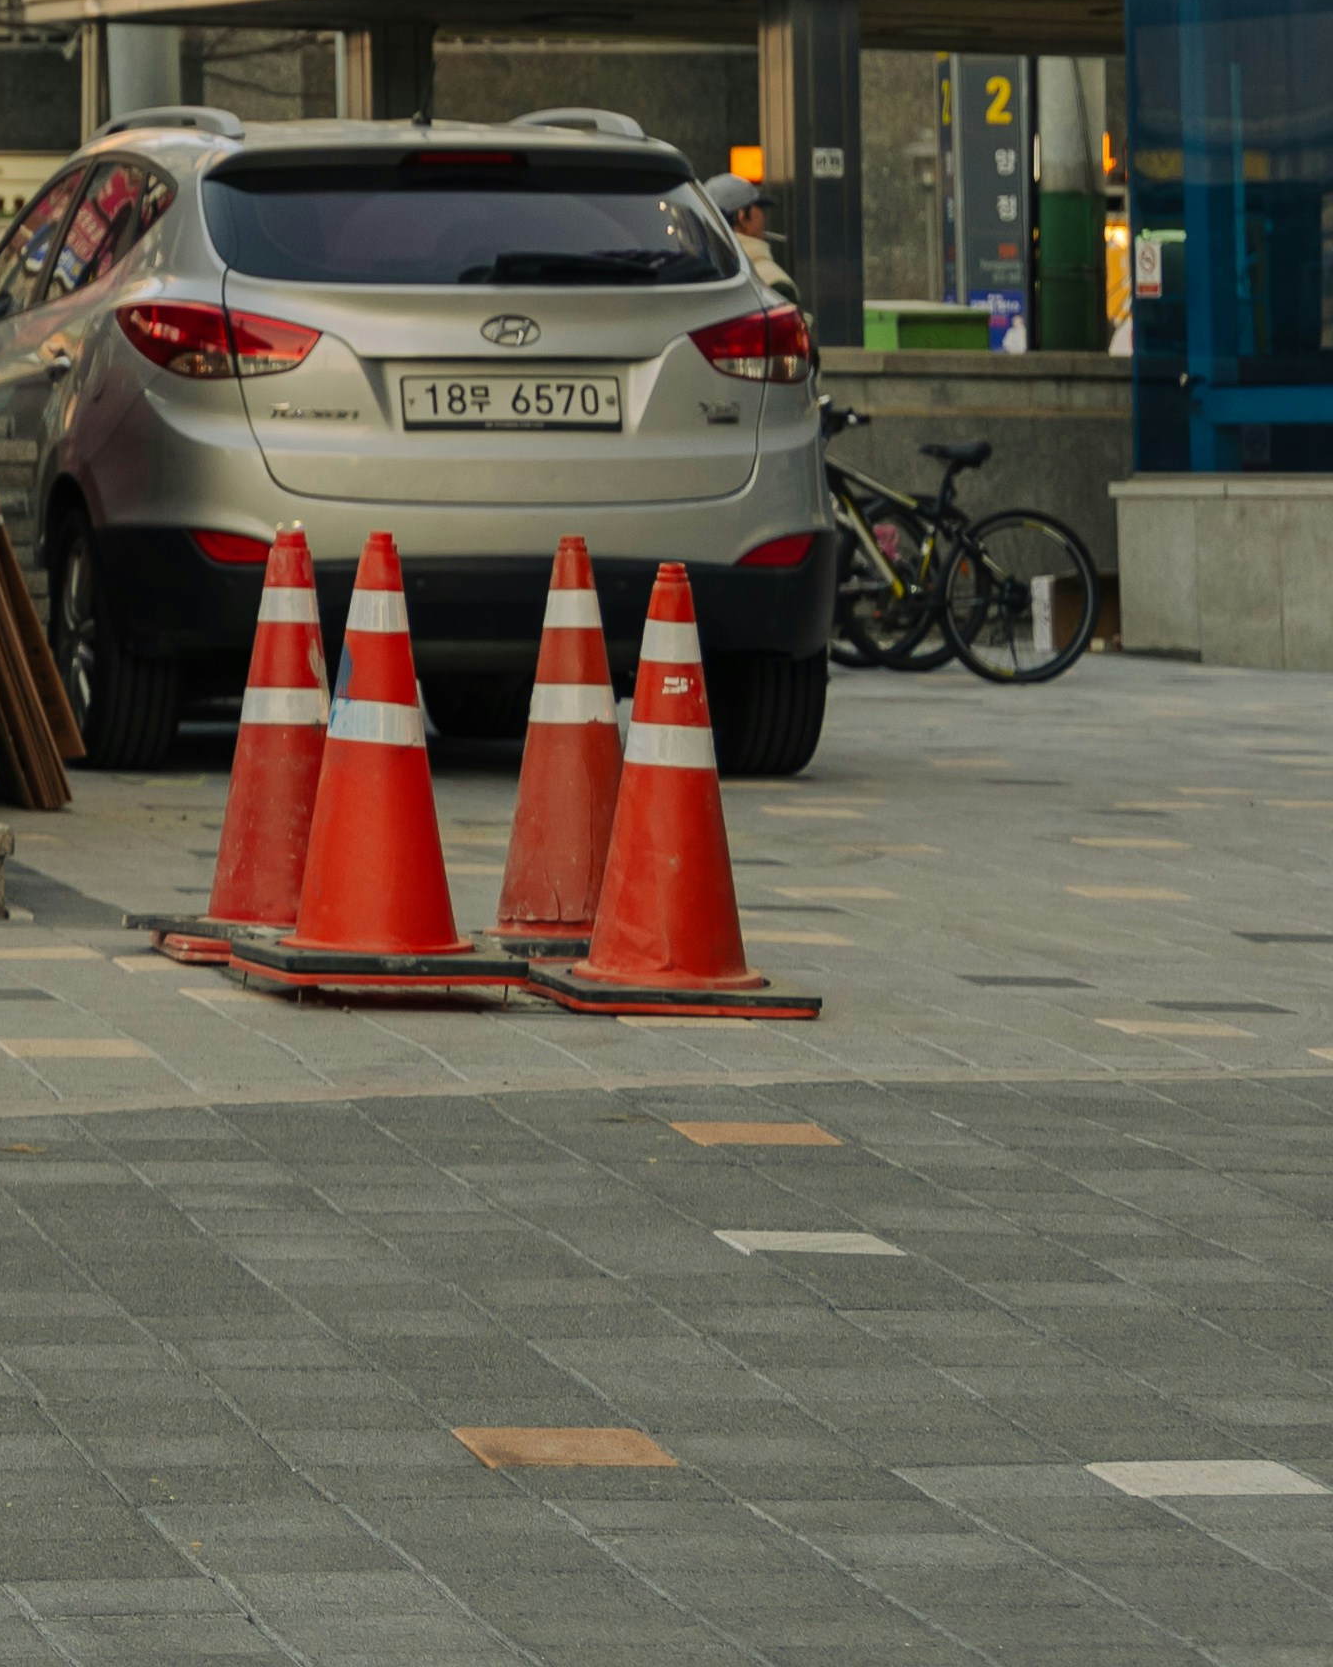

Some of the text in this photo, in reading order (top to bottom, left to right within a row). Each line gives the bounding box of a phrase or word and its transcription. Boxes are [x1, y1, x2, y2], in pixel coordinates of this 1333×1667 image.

[985, 75, 1013, 125] 2
[425, 383, 601, 417] 18무 6570
